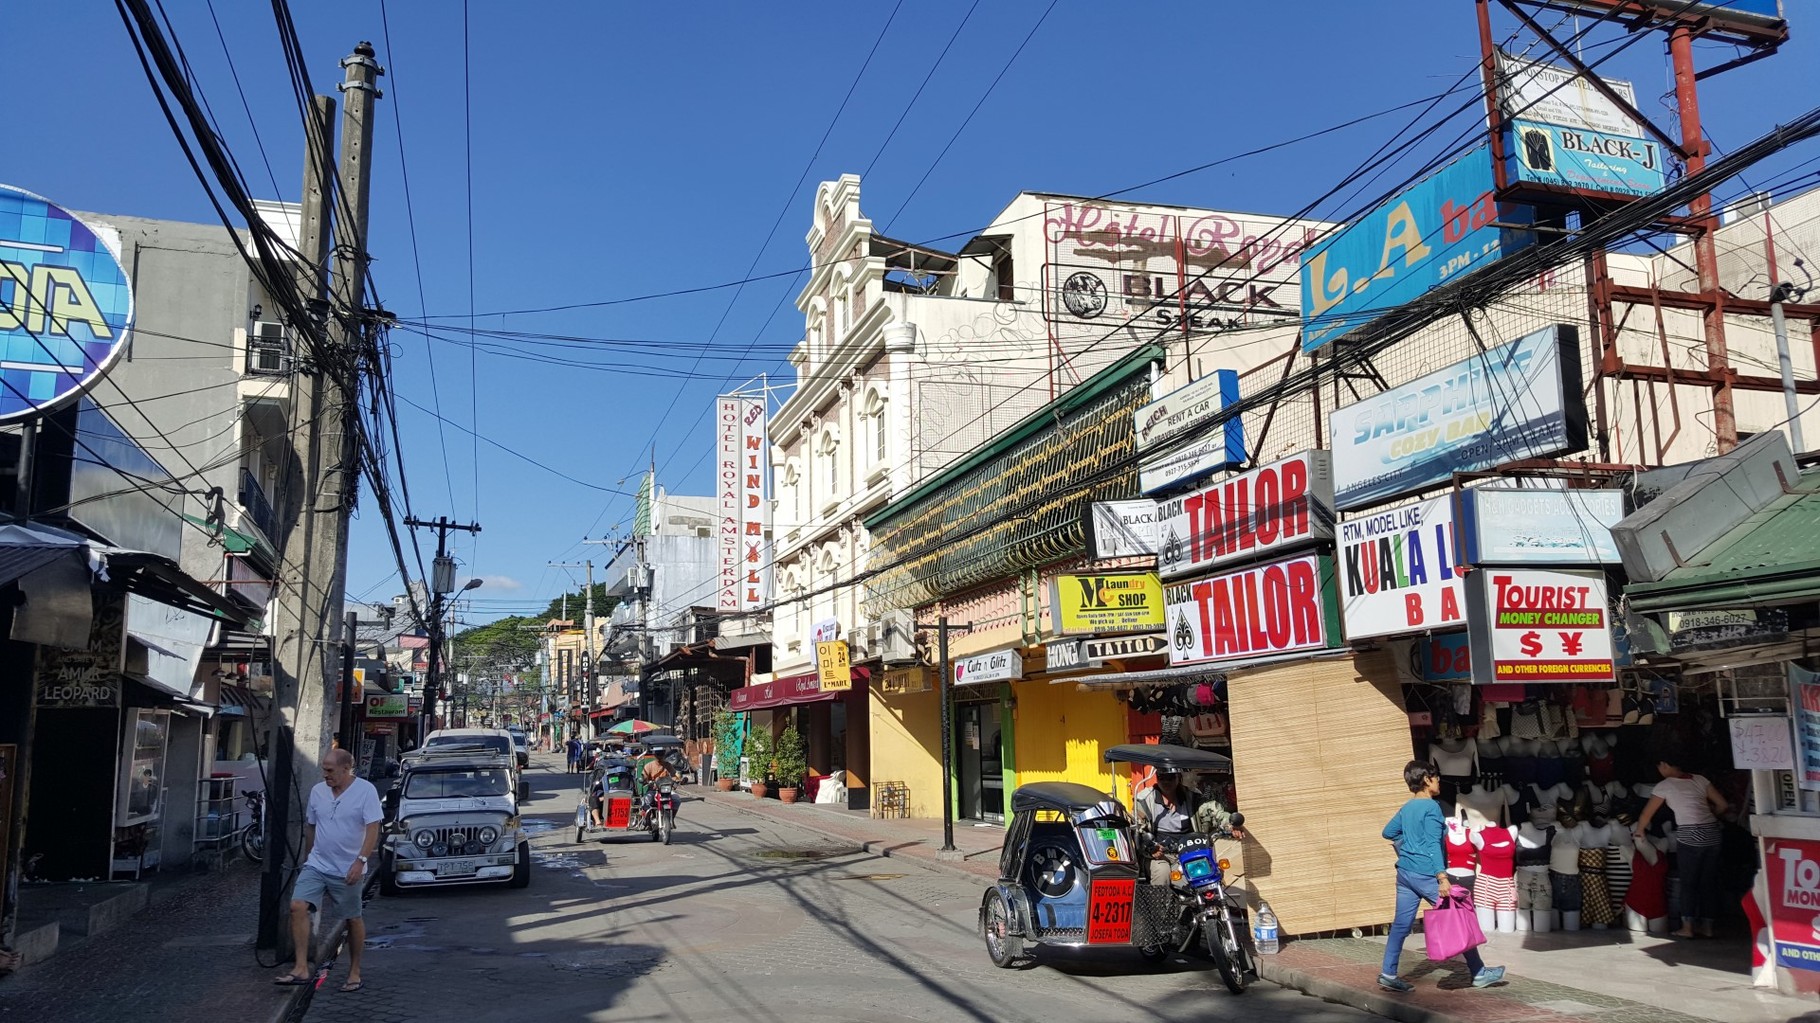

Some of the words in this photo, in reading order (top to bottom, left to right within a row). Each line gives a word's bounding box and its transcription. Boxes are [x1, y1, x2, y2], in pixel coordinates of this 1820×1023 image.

[1561, 131, 1655, 170] BLACK-J
[1584, 158, 1627, 174] Tailoring
[1044, 202, 1169, 247] Hotel
[1438, 252, 1470, 280] 3PM
[1122, 274, 1283, 309] BLACK
[1156, 307, 1244, 329] STEAK
[1353, 347, 1534, 446] SAPPHIRE
[744, 404, 763, 427] RED
[1141, 404, 1168, 442] REICH
[1167, 411, 1186, 427] RENT
[1187, 408, 1193, 419] A
[1194, 400, 1210, 415] CAR
[722, 403, 736, 453] HOTEL
[1389, 426, 1441, 460] COZY
[1443, 411, 1492, 443] BAR
[722, 460, 736, 509] ROYAL
[746, 435, 762, 509] WIND
[1158, 498, 1183, 523] BLACK
[1184, 458, 1310, 565] TAILOR
[1366, 513, 1399, 534] MODEL
[1400, 506, 1424, 531] LIKE,
[721, 516, 737, 608] AMSTERDAM
[1345, 529, 1427, 598] KUALA
[1106, 579, 1146, 590] Laundry
[1493, 575, 1590, 610] TOURIST
[1118, 593, 1147, 607] SHOP
[1167, 584, 1193, 606] BLACK
[1192, 561, 1321, 657] TAILOR
[1499, 611, 1542, 626] MONEY
[1544, 612, 1600, 626] CHANGER
[1680, 613, 1747, 629] 0918-346-6027
[838, 651, 846, 663] 24
[1094, 637, 1156, 657] TATTOO
[1520, 631, 1543, 658] $
[819, 646, 836, 680] 이마트
[967, 659, 982, 674] Cutz
[990, 655, 1007, 670] Glitz
[1497, 664, 1514, 674] AND
[1515, 664, 1538, 674] OTHER
[1538, 663, 1569, 674] FOREIGN
[1570, 663, 1611, 674] CURRENCIES
[45, 685, 111, 700] LEOPARD
[1092, 901, 1132, 924] 4-2317
[1091, 927, 1112, 940] JOSEFA
[1114, 927, 1129, 939] TODA
[1781, 947, 1800, 959] AND
[1801, 948, 1820, 962] OTH
